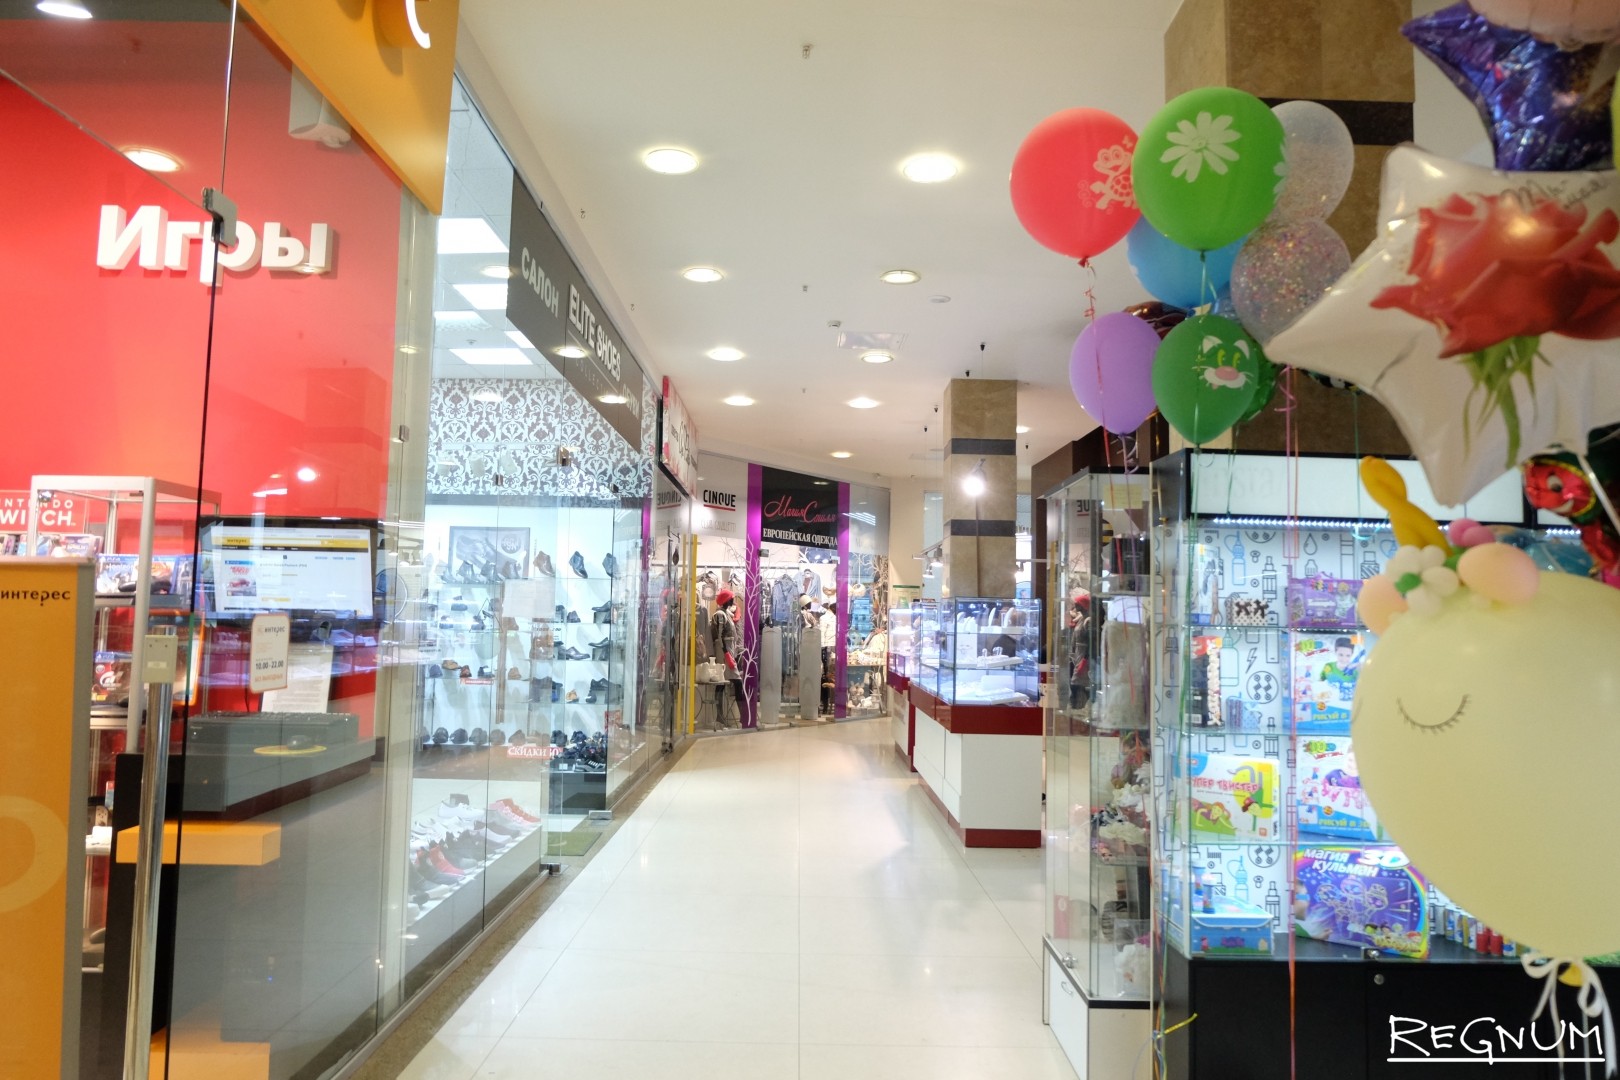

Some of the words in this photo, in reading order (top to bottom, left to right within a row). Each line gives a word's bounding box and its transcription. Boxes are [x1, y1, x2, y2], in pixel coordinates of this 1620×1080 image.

[97, 204, 334, 287] Игры
[521, 246, 560, 319] САЛОН
[568, 283, 596, 350] ELITE
[595, 323, 621, 383] SHOES
[703, 489, 737, 508] CINQUE
[763, 494, 805, 519] Магия
[0, 509, 73, 526] WICH
[762, 527, 811, 543] ЕВРОПЕЙСКАЯ
[811, 533, 838, 548] ОДЕЖДА
[0, 590, 71, 607] интерес
[508, 746, 547, 758] СКИДКИ
